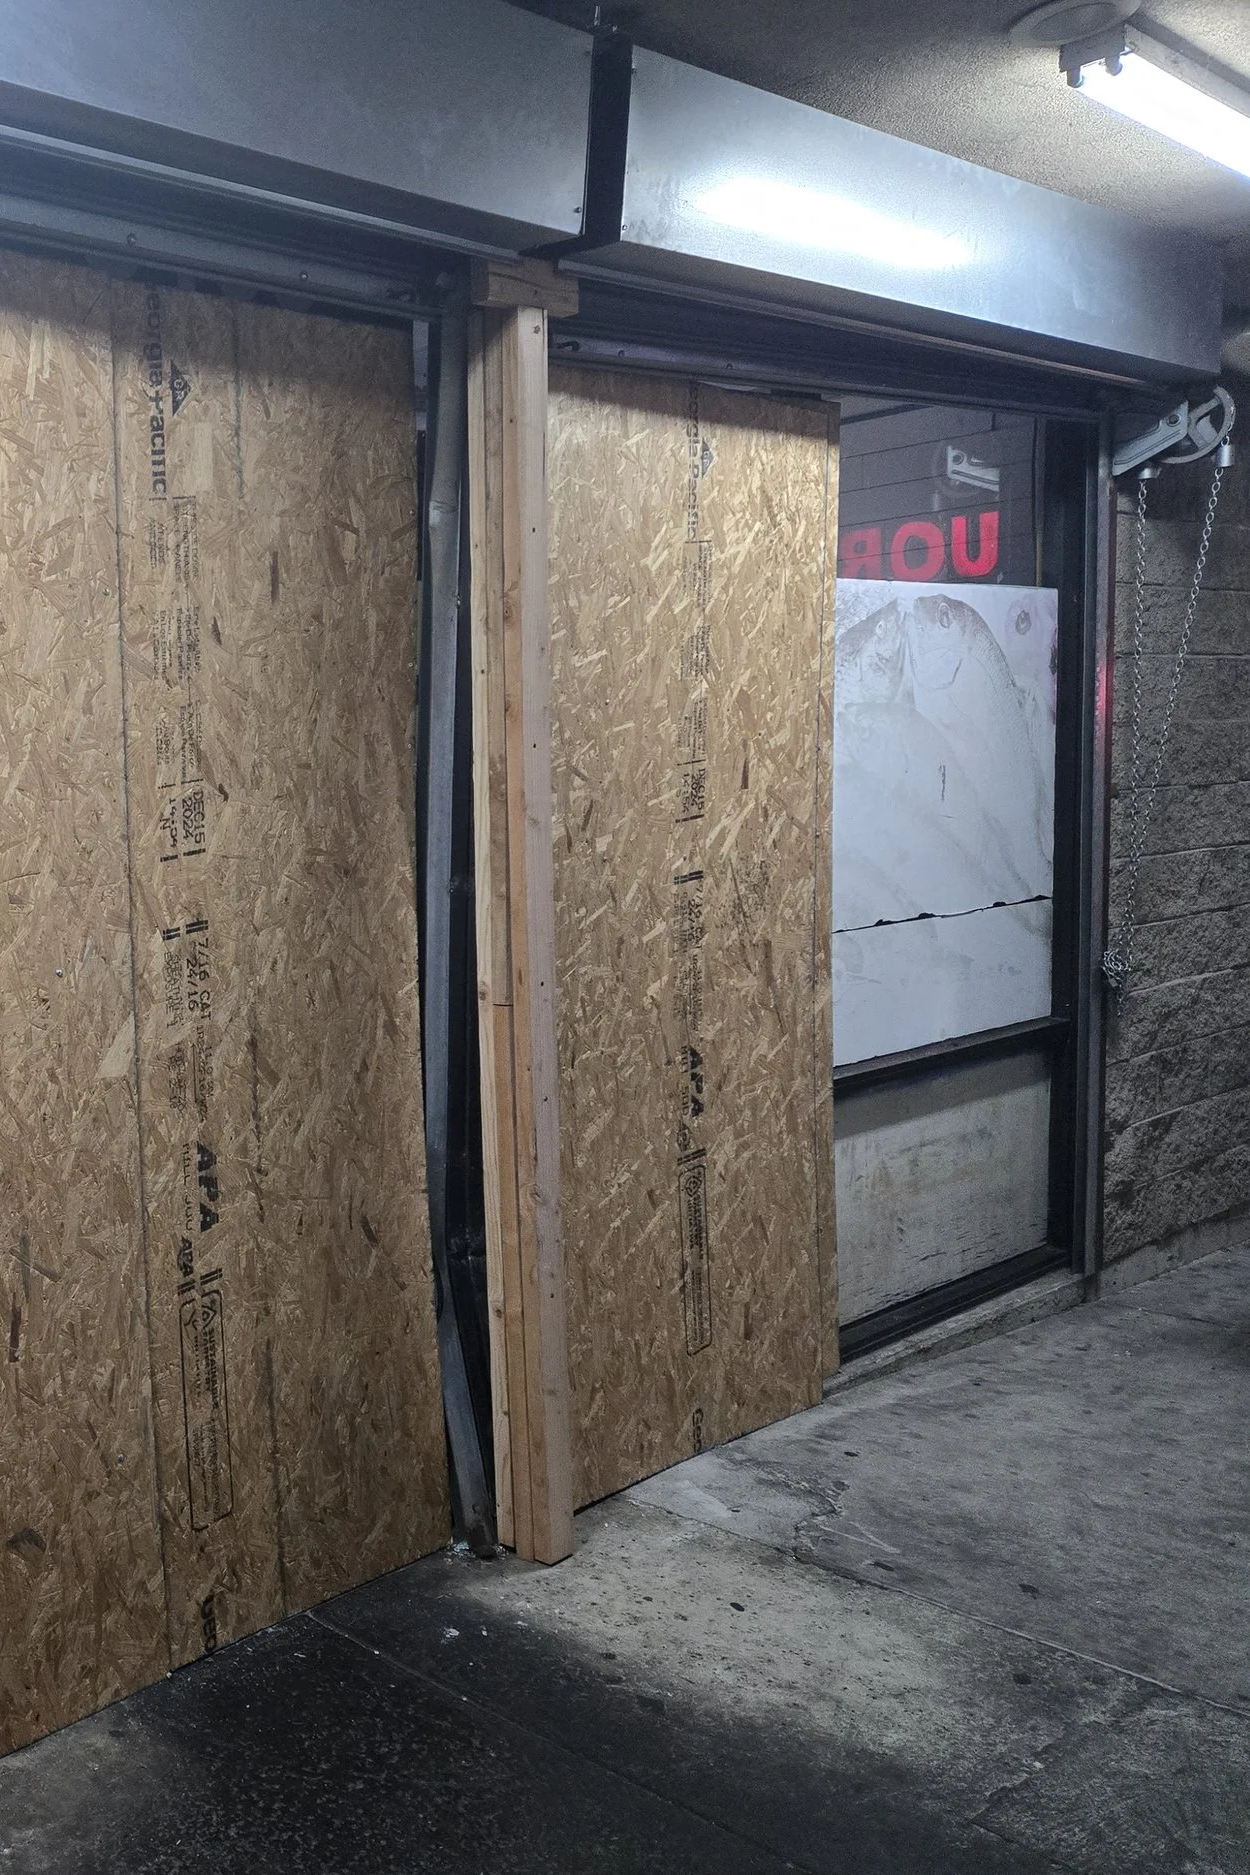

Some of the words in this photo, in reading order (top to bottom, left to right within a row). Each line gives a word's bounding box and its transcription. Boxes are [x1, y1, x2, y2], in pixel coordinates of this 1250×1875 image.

[690, 773, 699, 807] 2024
[697, 768, 706, 811] DEC15
[181, 799, 195, 840] 2024
[193, 791, 206, 845] DEC15
[198, 937, 210, 981] 7/16
[186, 958, 199, 1011] 24/16
[200, 989, 212, 1021] CAT
[690, 1044, 704, 1118] APA
[197, 1140, 220, 1233] APA
